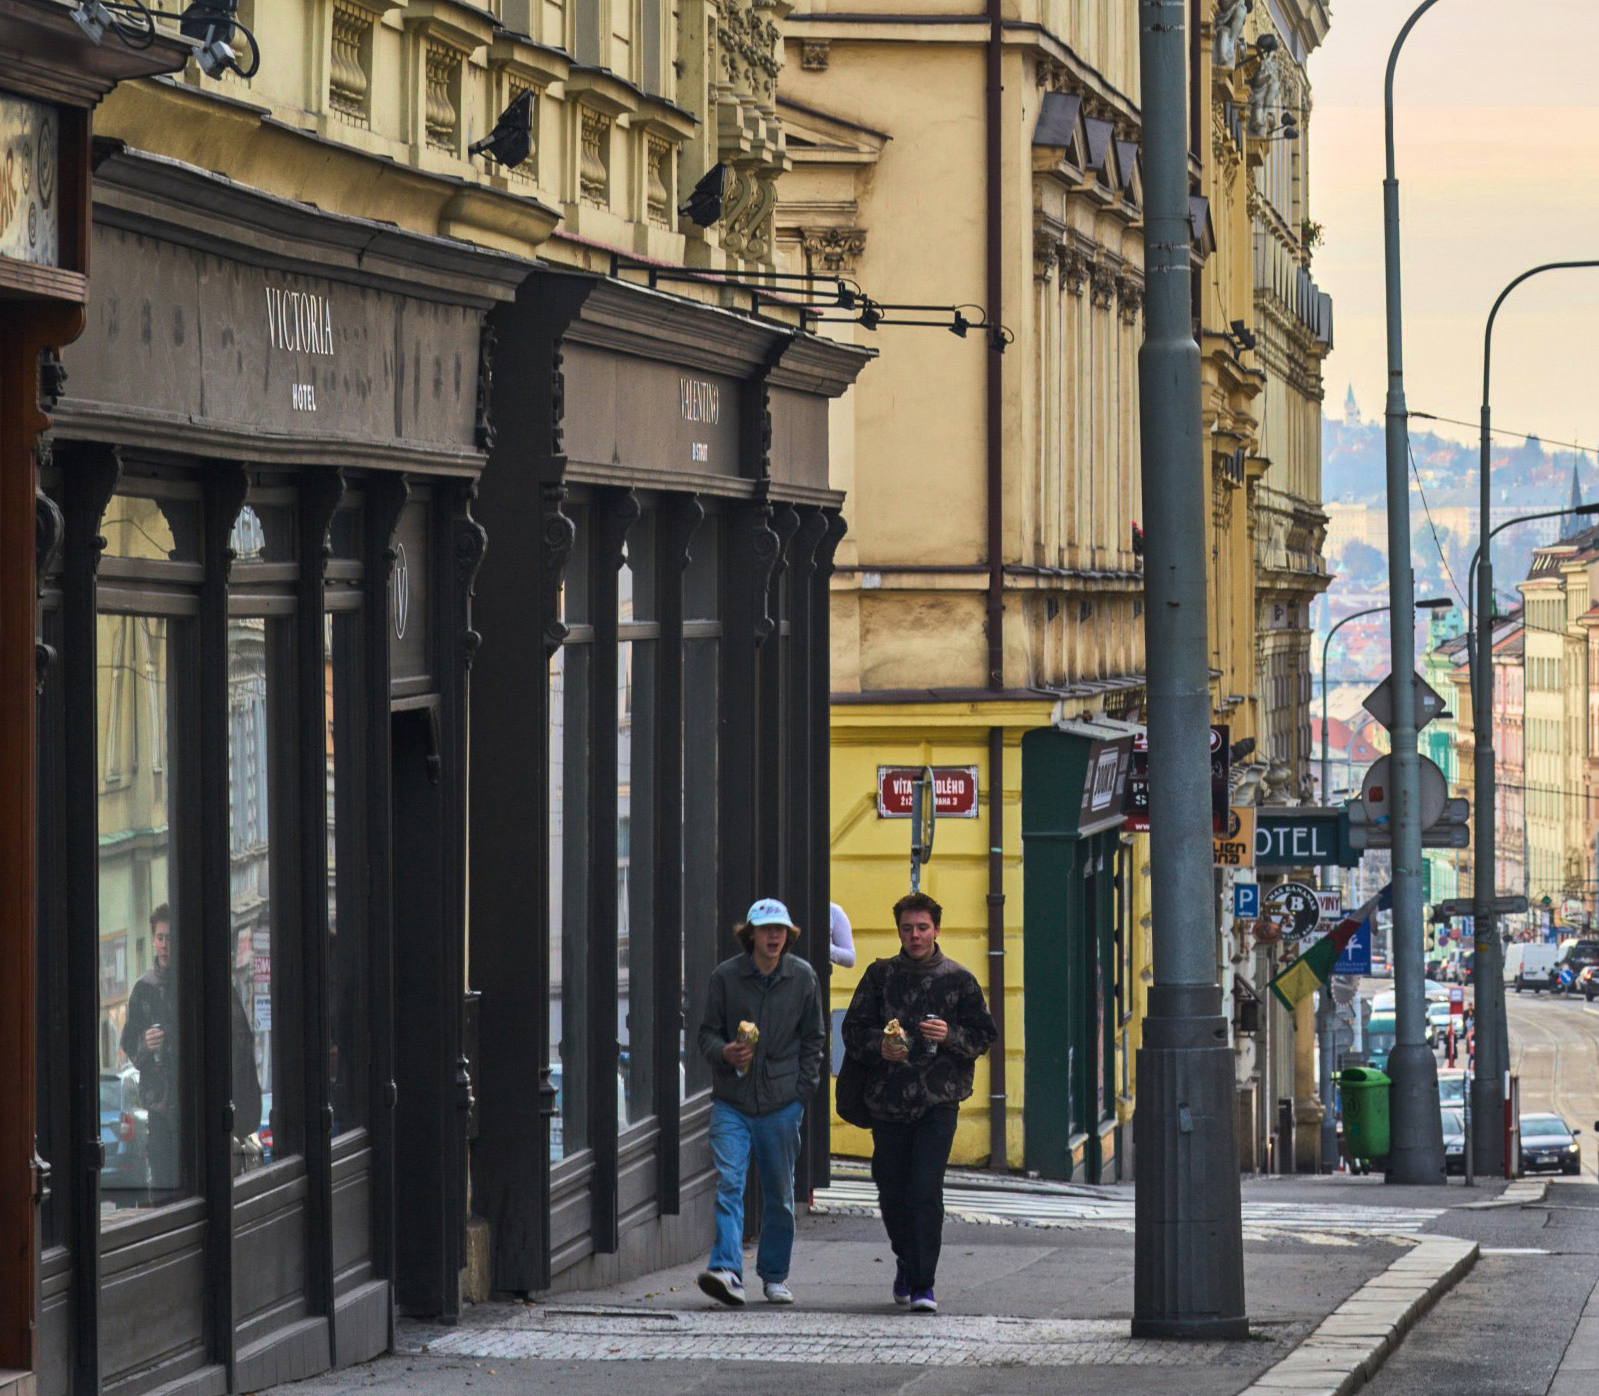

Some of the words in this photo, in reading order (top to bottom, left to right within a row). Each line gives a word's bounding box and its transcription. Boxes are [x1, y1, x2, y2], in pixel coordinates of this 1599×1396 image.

[265, 287, 334, 356] VICTORIA
[292, 383, 317, 412] HOTEL
[680, 378, 719, 425] VALENTINO
[1256, 827, 1327, 856] OTEL
[1239, 888, 1254, 909] P
[1290, 895, 1304, 911] B
